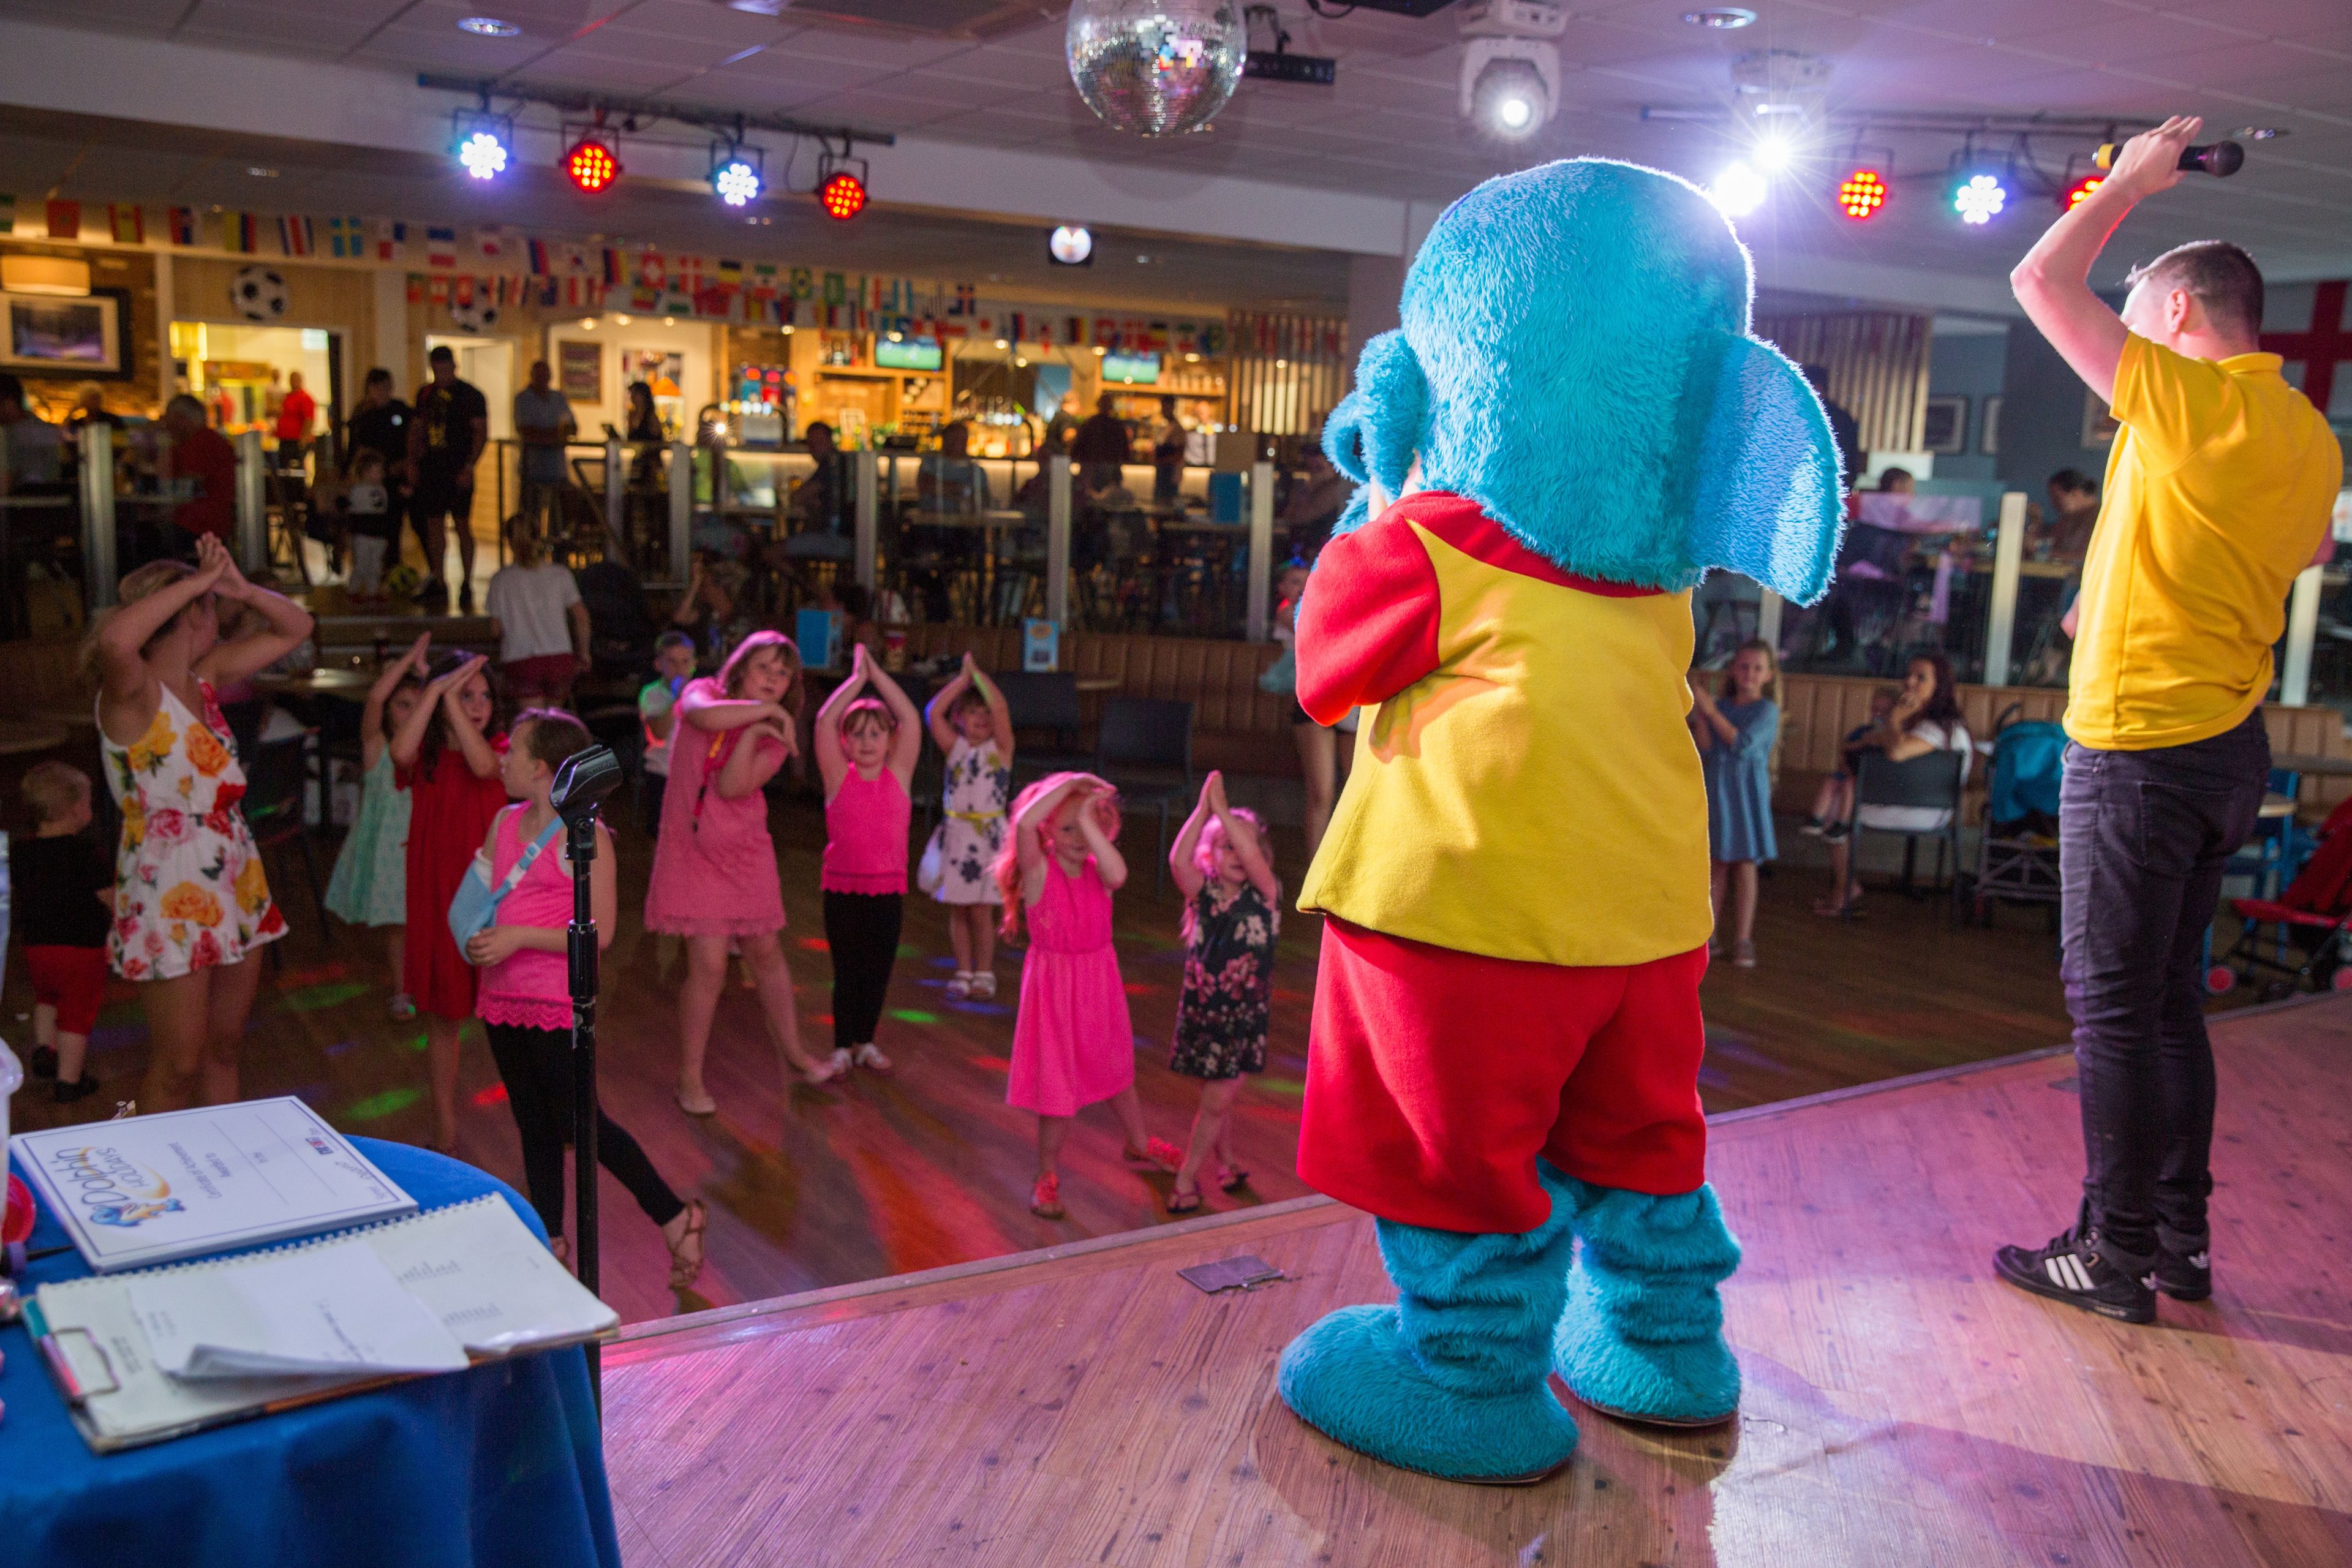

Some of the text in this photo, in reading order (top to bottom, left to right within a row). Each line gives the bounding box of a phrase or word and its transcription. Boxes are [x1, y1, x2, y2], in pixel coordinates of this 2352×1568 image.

[96, 1147, 150, 1188] HOLIDAYS
[168, 1142, 196, 1169] Achievement
[49, 1147, 130, 1205] Dolphin
[197, 1175, 222, 1199] Certificate
